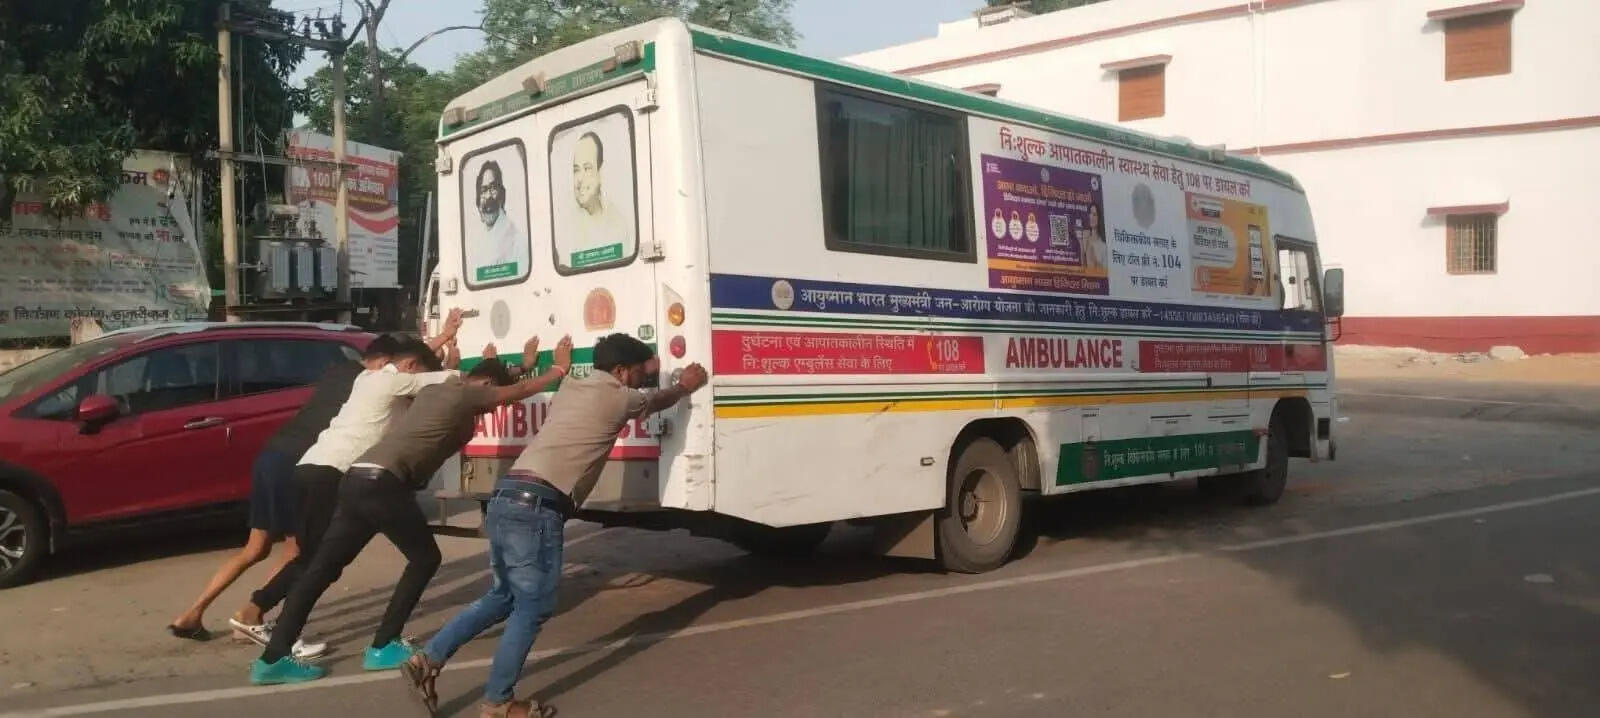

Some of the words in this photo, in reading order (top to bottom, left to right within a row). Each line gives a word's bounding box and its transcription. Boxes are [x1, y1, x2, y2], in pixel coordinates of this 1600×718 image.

[1048, 142, 1115, 173] आपातकालीन
[1118, 157, 1150, 177] स्वास्थ्य
[1151, 159, 1169, 182] सेवा
[1170, 162, 1185, 191] हेतु
[1185, 172, 1200, 188] 108
[1202, 175, 1213, 190] पर
[1214, 177, 1237, 195] डायल
[1161, 254, 1182, 270] 104
[800, 289, 853, 310] आयुष्मान
[856, 291, 886, 307] भारत
[888, 291, 933, 313] मुख्यमंत्री
[993, 296, 1023, 313] योजना
[1038, 299, 1072, 317] जानकारी
[1074, 301, 1086, 320] हेतु
[742, 335, 783, 352] दुर्घटना
[803, 334, 874, 351] आपातकालीन
[875, 336, 905, 351] स्थिति
[936, 339, 960, 362] 108
[1005, 336, 1123, 369] AMBULANCE
[837, 356, 858, 370] सेवा
[860, 355, 871, 369] के
[872, 355, 893, 372] लिए
